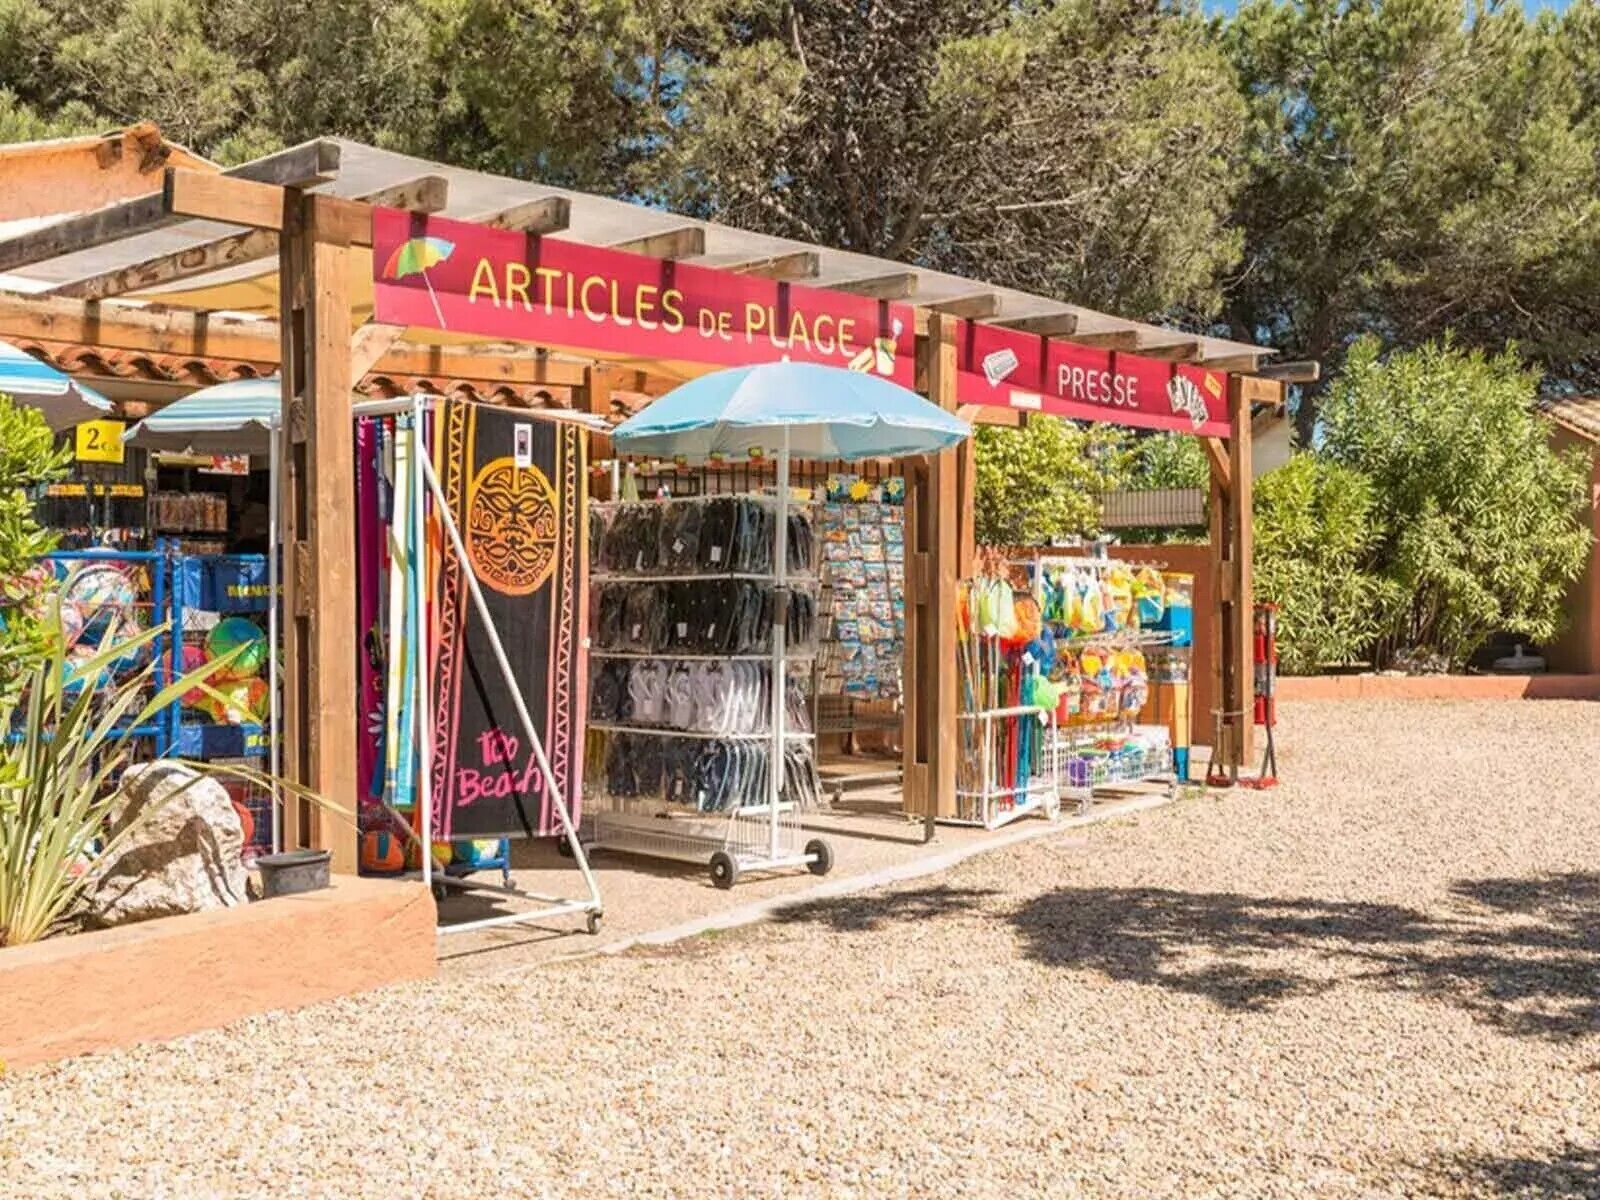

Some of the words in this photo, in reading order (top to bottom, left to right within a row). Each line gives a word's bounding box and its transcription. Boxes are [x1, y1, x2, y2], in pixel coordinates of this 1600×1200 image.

[468, 258, 684, 333] ARTICLES
[699, 308, 733, 341] DE
[745, 303, 857, 357] PLAGE
[1058, 364, 1139, 407] PRESSE
[456, 752, 542, 806] Beach
